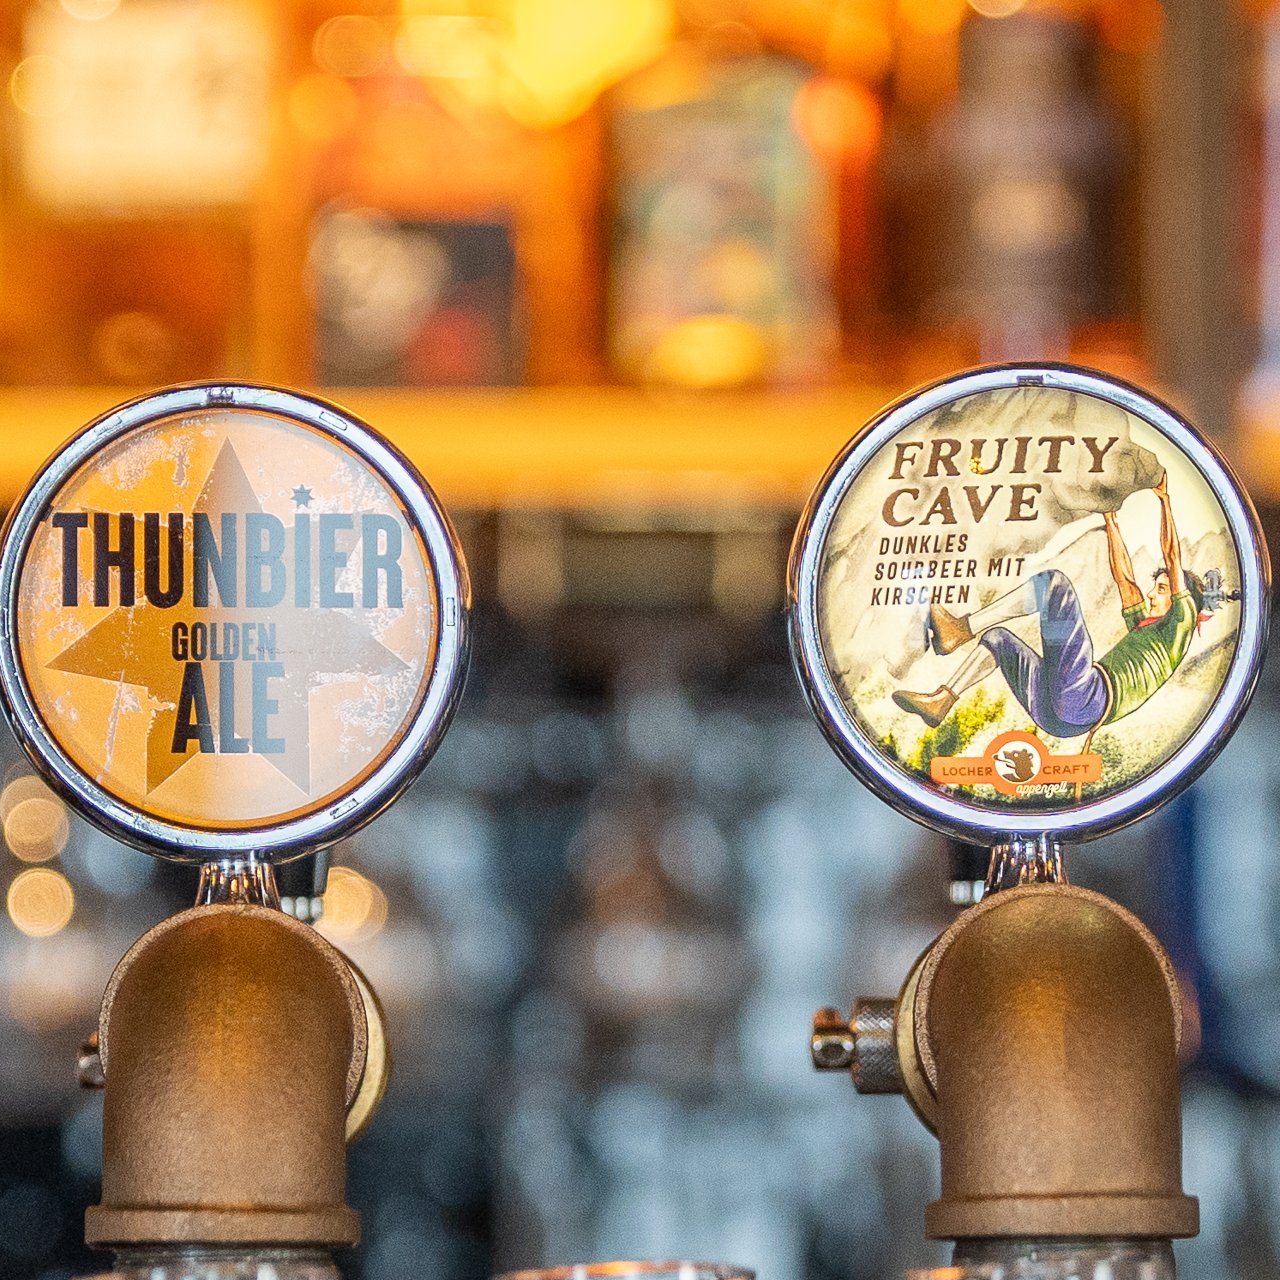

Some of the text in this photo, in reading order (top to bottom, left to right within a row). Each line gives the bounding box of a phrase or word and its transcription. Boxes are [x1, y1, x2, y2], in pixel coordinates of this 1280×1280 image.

[888, 435, 1119, 480] FRUITY
[881, 484, 1042, 527] CAVE
[52, 483, 404, 609] THUNBIER
[878, 534, 968, 556] DUNKLES
[875, 556, 1026, 581] SOURBEER MIT
[870, 585, 970, 606] KIRSCHEN
[171, 621, 277, 662] GOLDEN
[171, 661, 286, 755] ALE
[942, 764, 1090, 777] LOCHER CRAFT
[1015, 780, 1069, 799] appenzell
